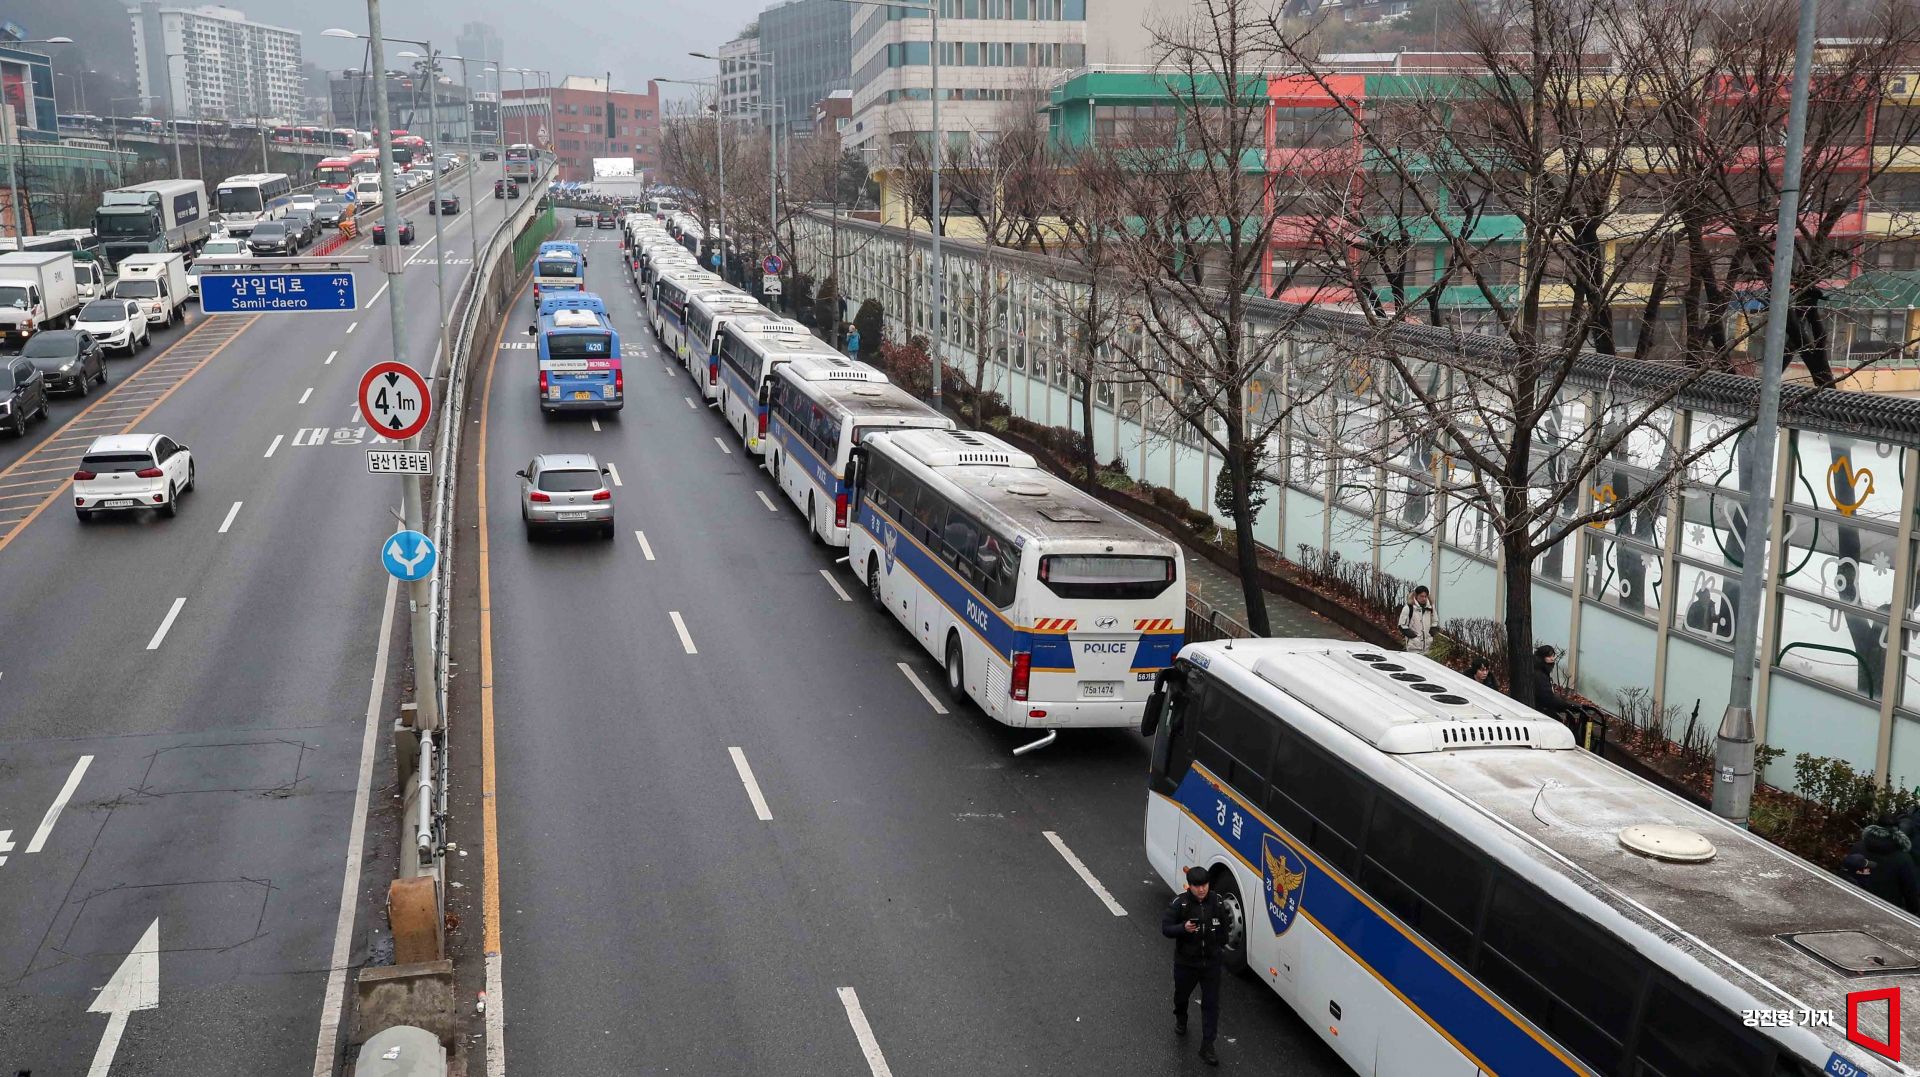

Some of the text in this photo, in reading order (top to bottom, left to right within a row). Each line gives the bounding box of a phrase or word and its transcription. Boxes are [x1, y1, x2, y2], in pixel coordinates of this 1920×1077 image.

[231, 278, 305, 295] 삼일대로
[231, 298, 308, 308] Samil-daero
[588, 343, 602, 351] 420
[375, 387, 415, 414] 4.1m
[370, 453, 428, 472] 남산1호터널
[966, 599, 988, 631] POLICE
[1083, 643, 1127, 654] POLICE
[1269, 902, 1288, 924] POLICE
